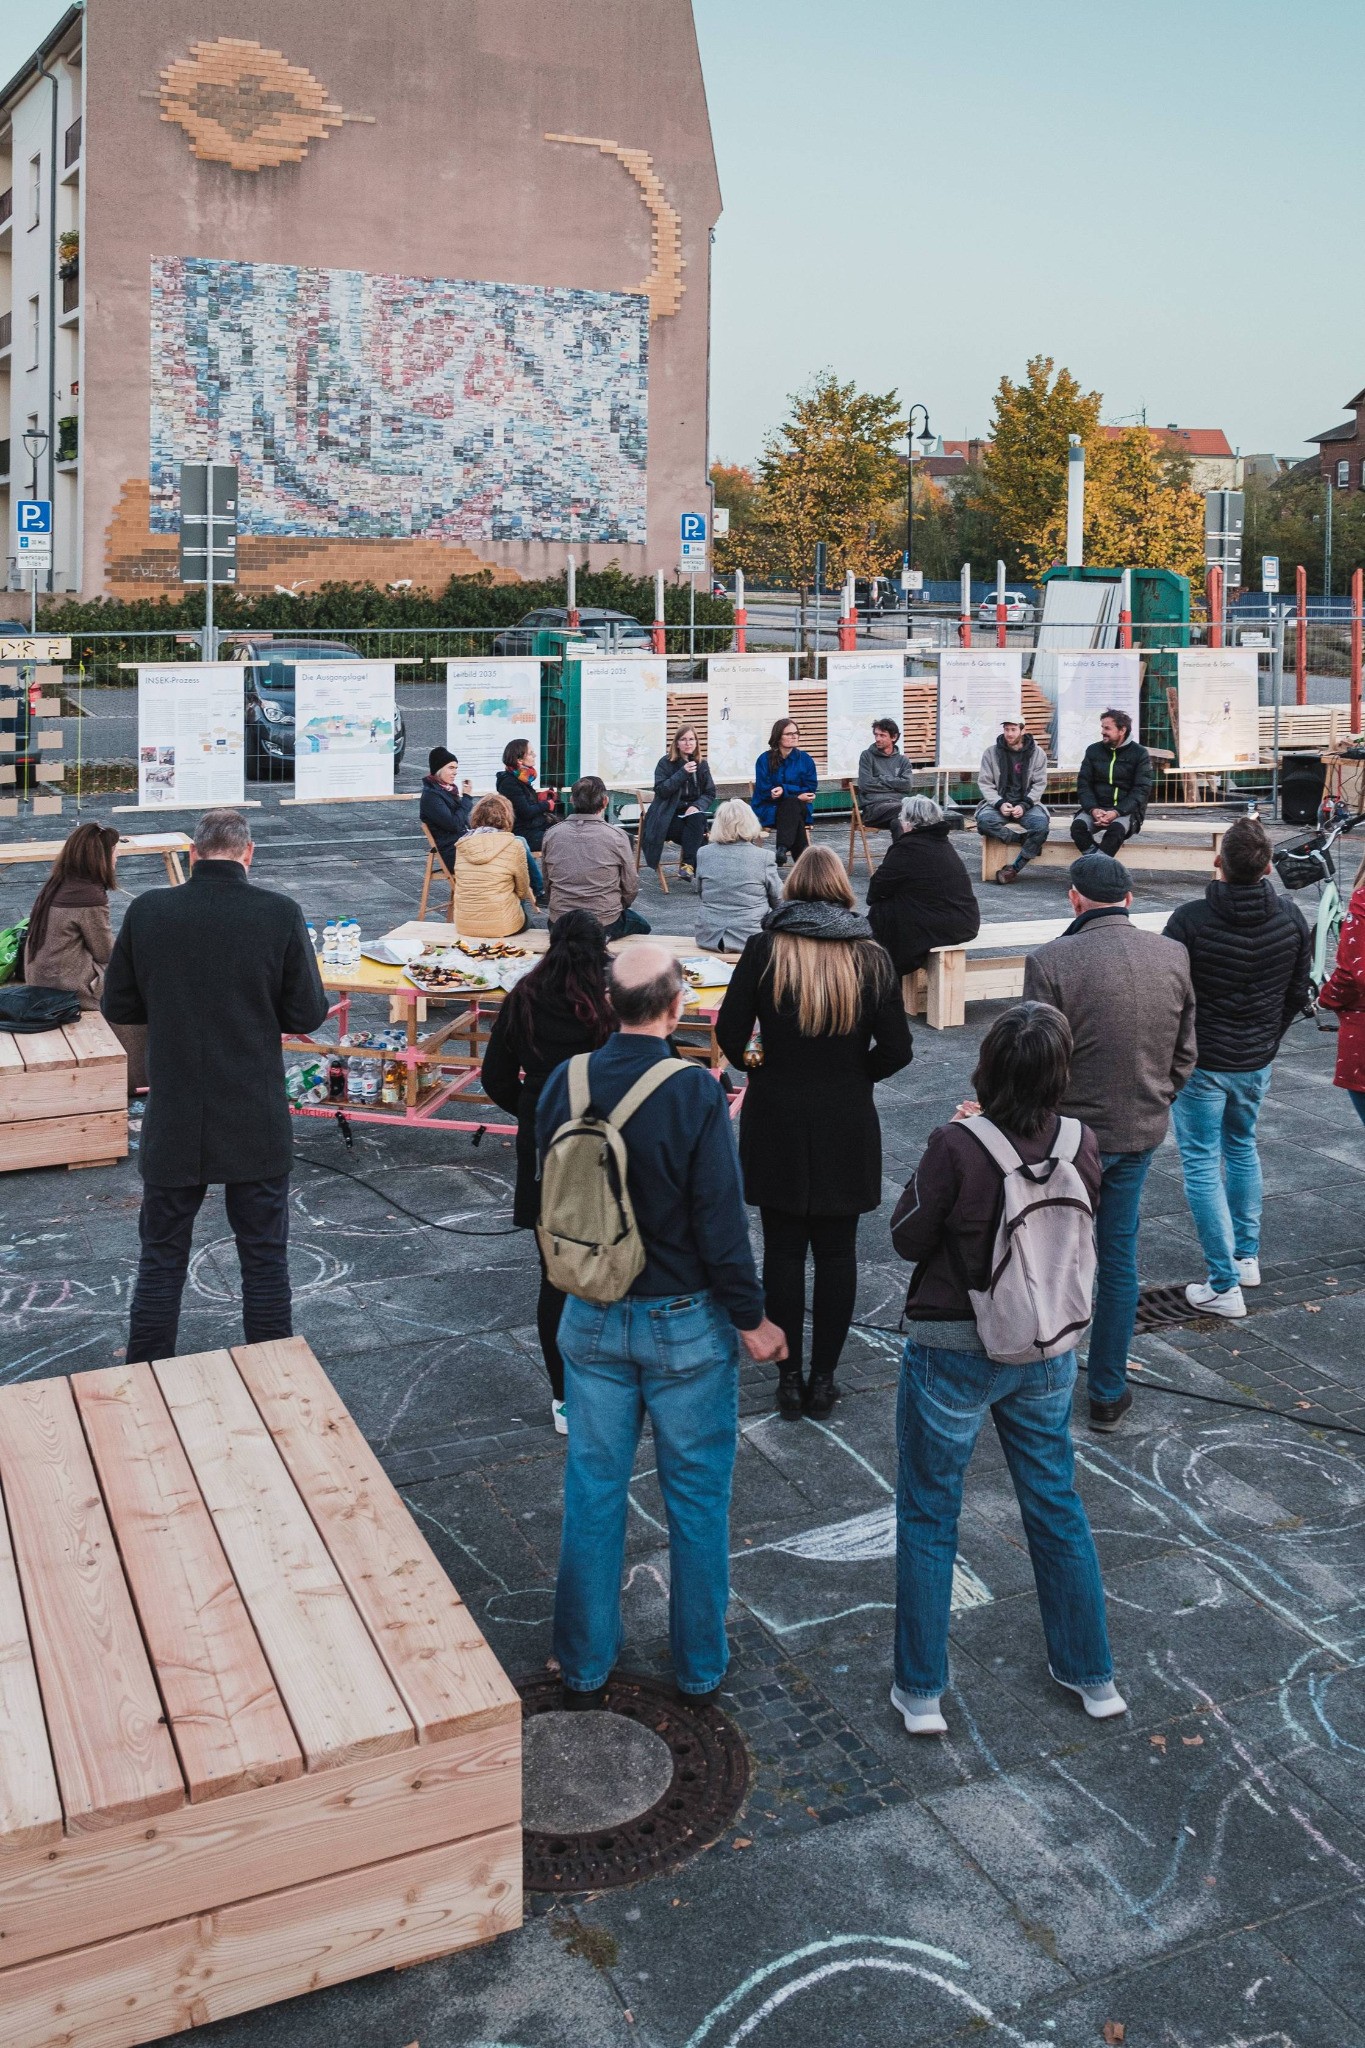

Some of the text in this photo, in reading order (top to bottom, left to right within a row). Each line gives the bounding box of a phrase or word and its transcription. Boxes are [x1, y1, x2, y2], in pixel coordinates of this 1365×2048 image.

[22, 505, 41, 529] P
[684, 517, 699, 538] P
[1097, 660, 1119, 668] Energie
[586, 668, 609, 676] Leitbild
[713, 665, 730, 673] Kultur
[731, 665, 736, 673] &
[302, 672, 369, 683] Die Ausgangslage!
[453, 670, 497, 678] Leitbild 2035
[145, 676, 200, 685] INSEK-Prozess
